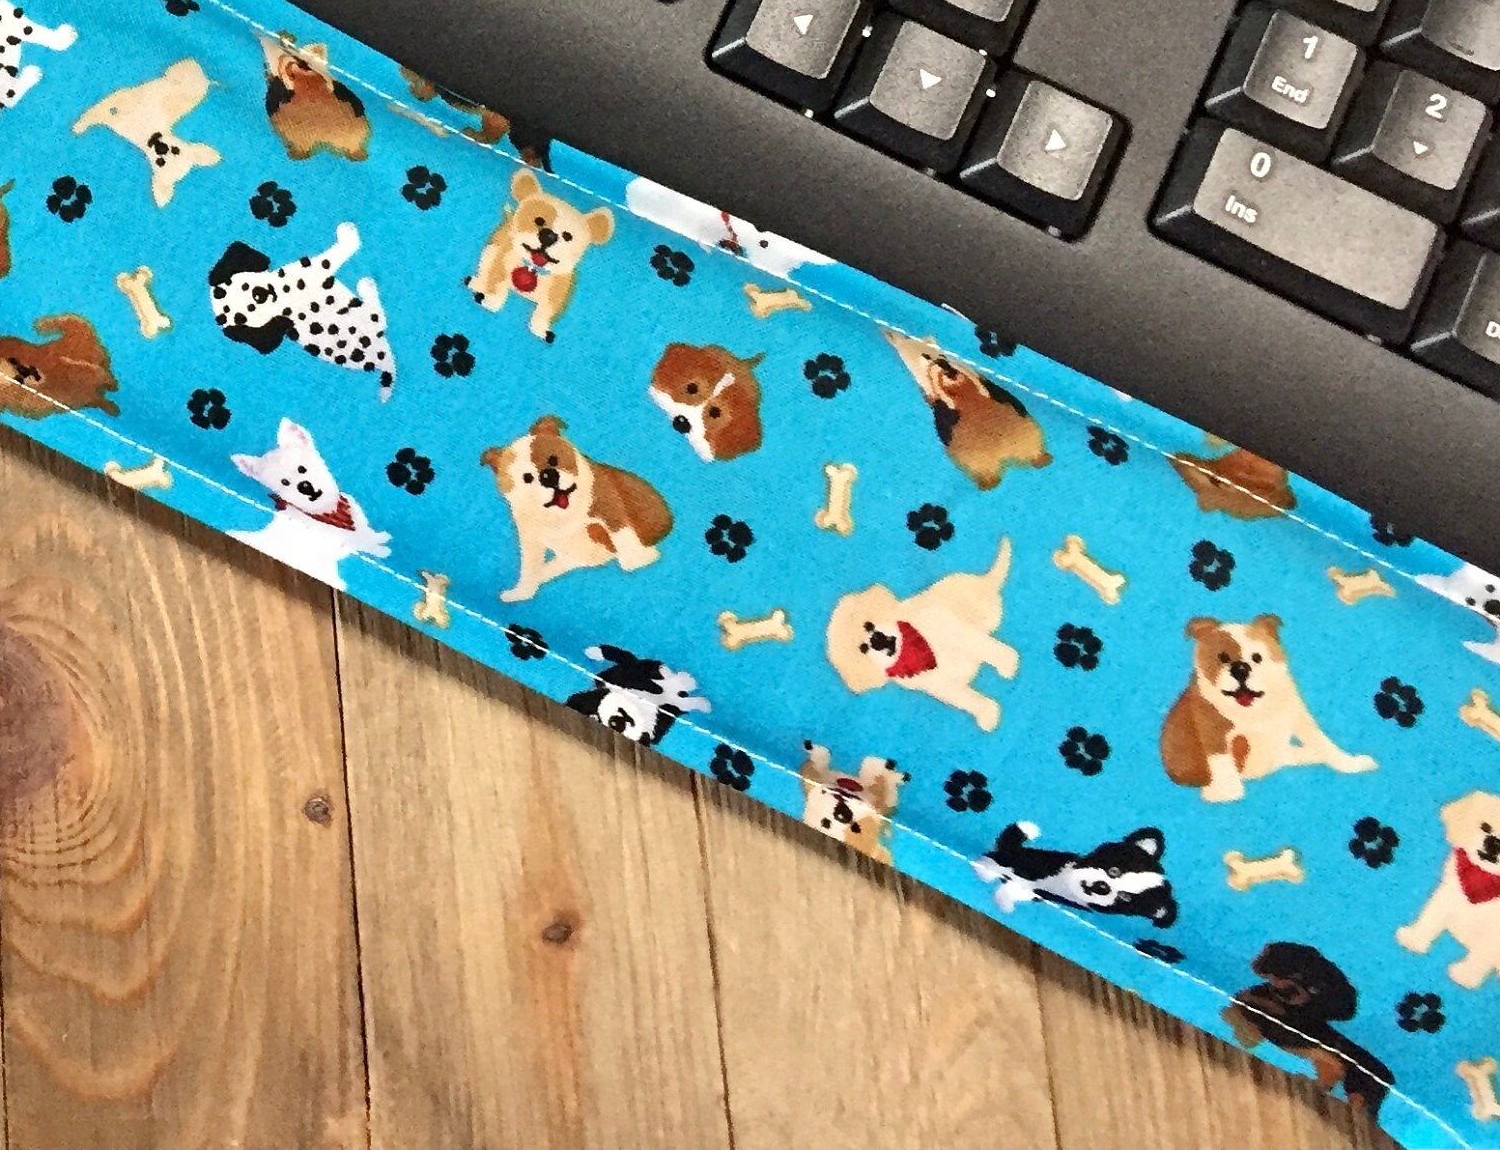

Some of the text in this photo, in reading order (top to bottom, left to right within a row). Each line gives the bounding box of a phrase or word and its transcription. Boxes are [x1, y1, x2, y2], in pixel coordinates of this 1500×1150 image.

[1302, 35, 1319, 59] 1
[1271, 74, 1312, 104] End
[1425, 93, 1448, 119] 2
[1250, 152, 1272, 178] 0
[1225, 194, 1258, 223] Ins
